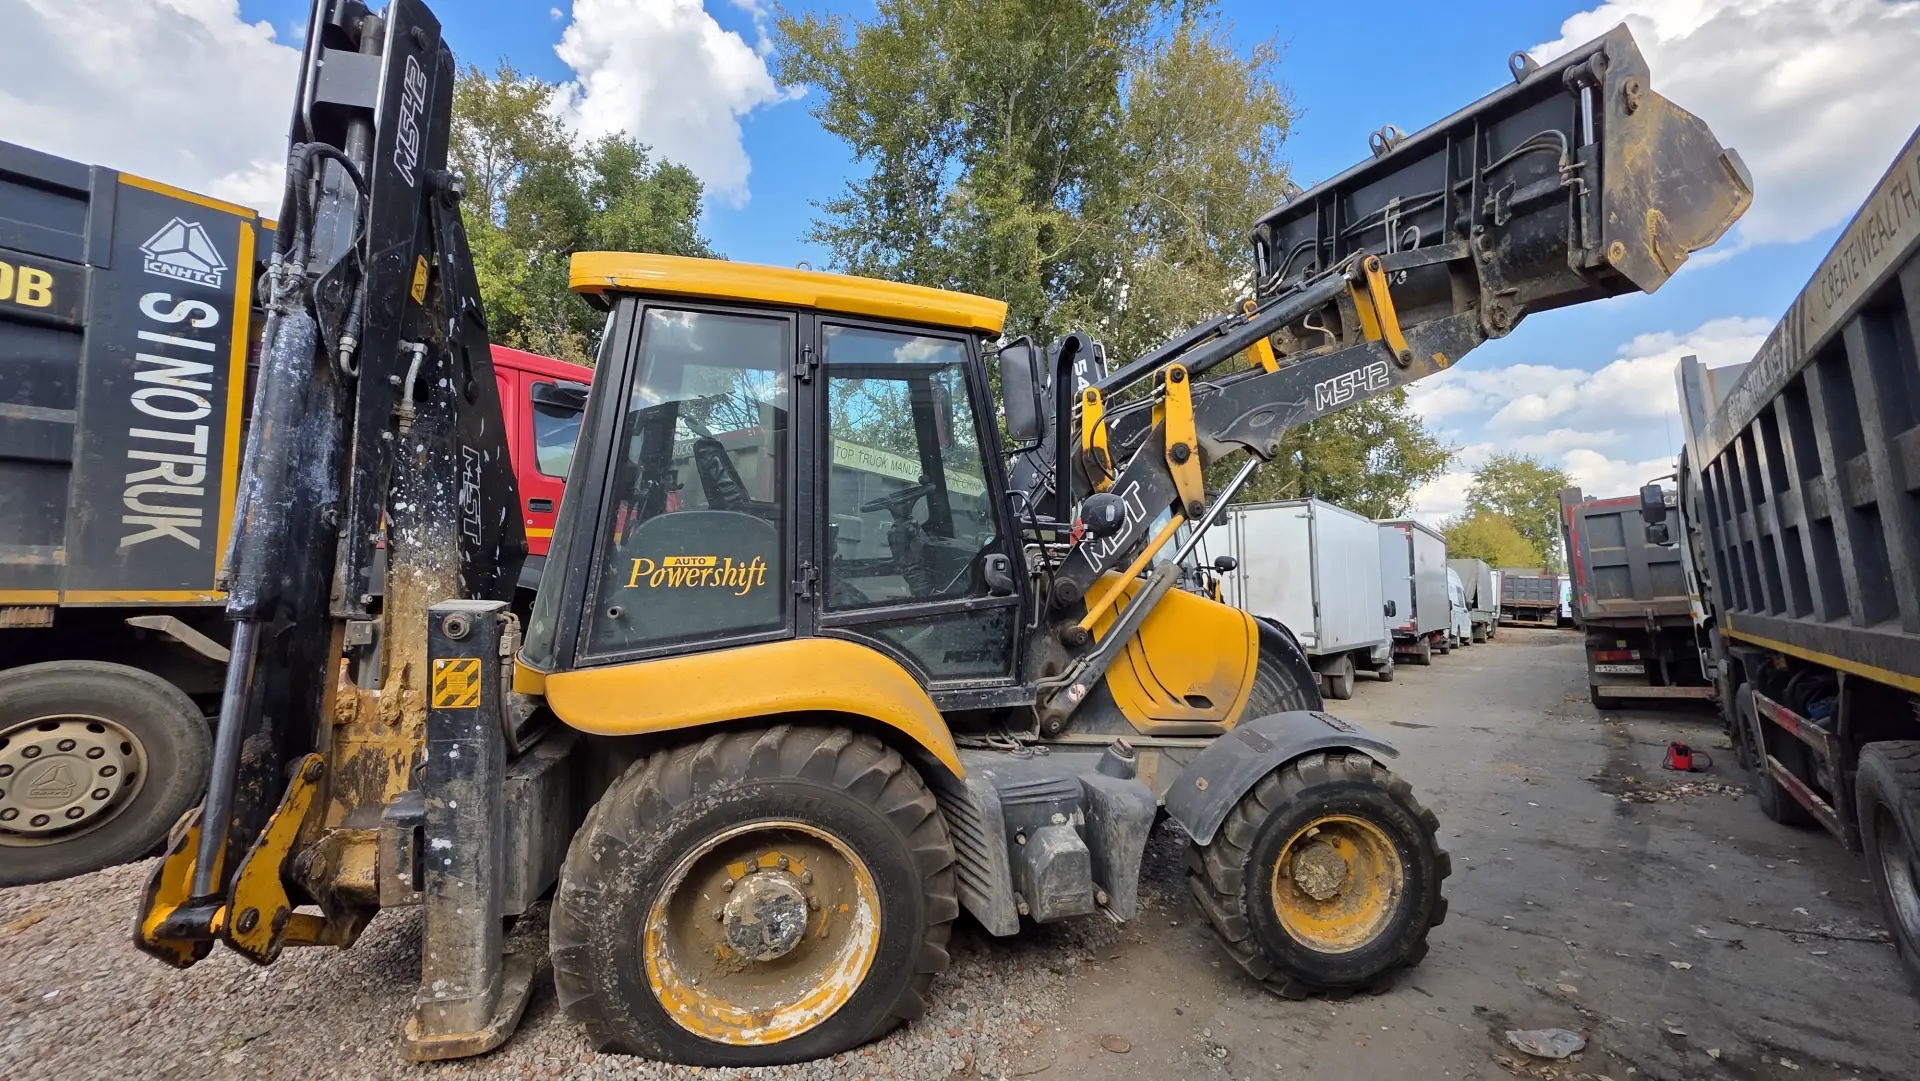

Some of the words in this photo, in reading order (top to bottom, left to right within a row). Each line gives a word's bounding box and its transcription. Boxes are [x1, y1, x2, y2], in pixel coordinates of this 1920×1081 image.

[148, 262, 217, 284] CNHTC
[119, 292, 220, 550] SINOTRUK
[835, 445, 855, 460] TOP
[858, 451, 888, 469] TRUCK
[674, 557, 707, 566] AUTO
[623, 555, 768, 596] Powershift
